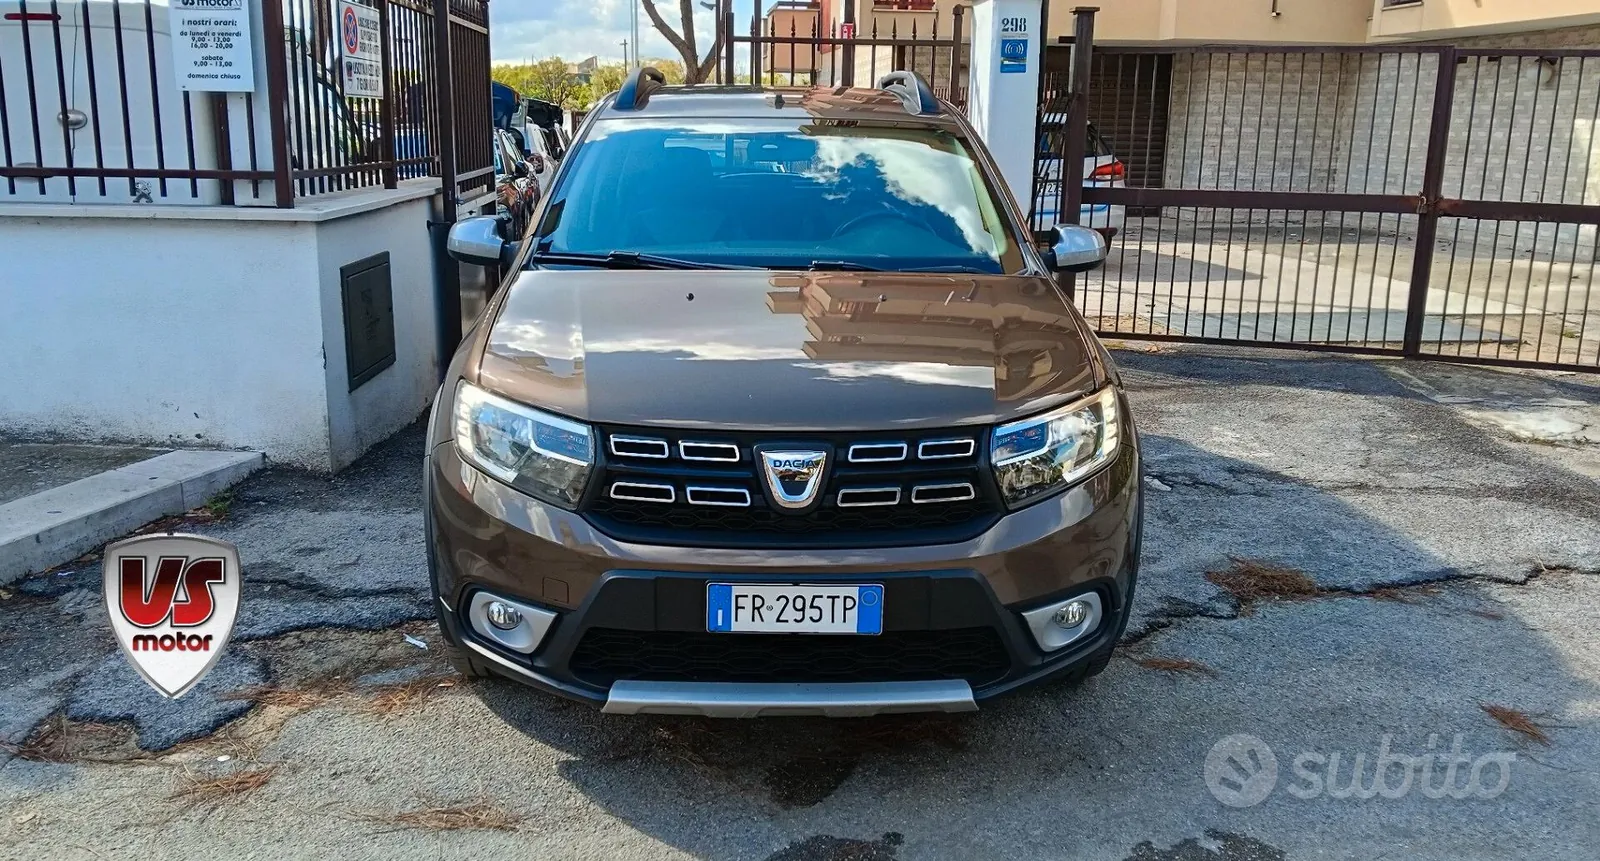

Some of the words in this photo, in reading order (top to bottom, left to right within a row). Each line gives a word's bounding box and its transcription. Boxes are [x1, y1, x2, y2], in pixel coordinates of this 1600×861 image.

[187, 18, 212, 26] nostri
[1001, 17, 1027, 32] 298
[773, 459, 815, 468] DACIA
